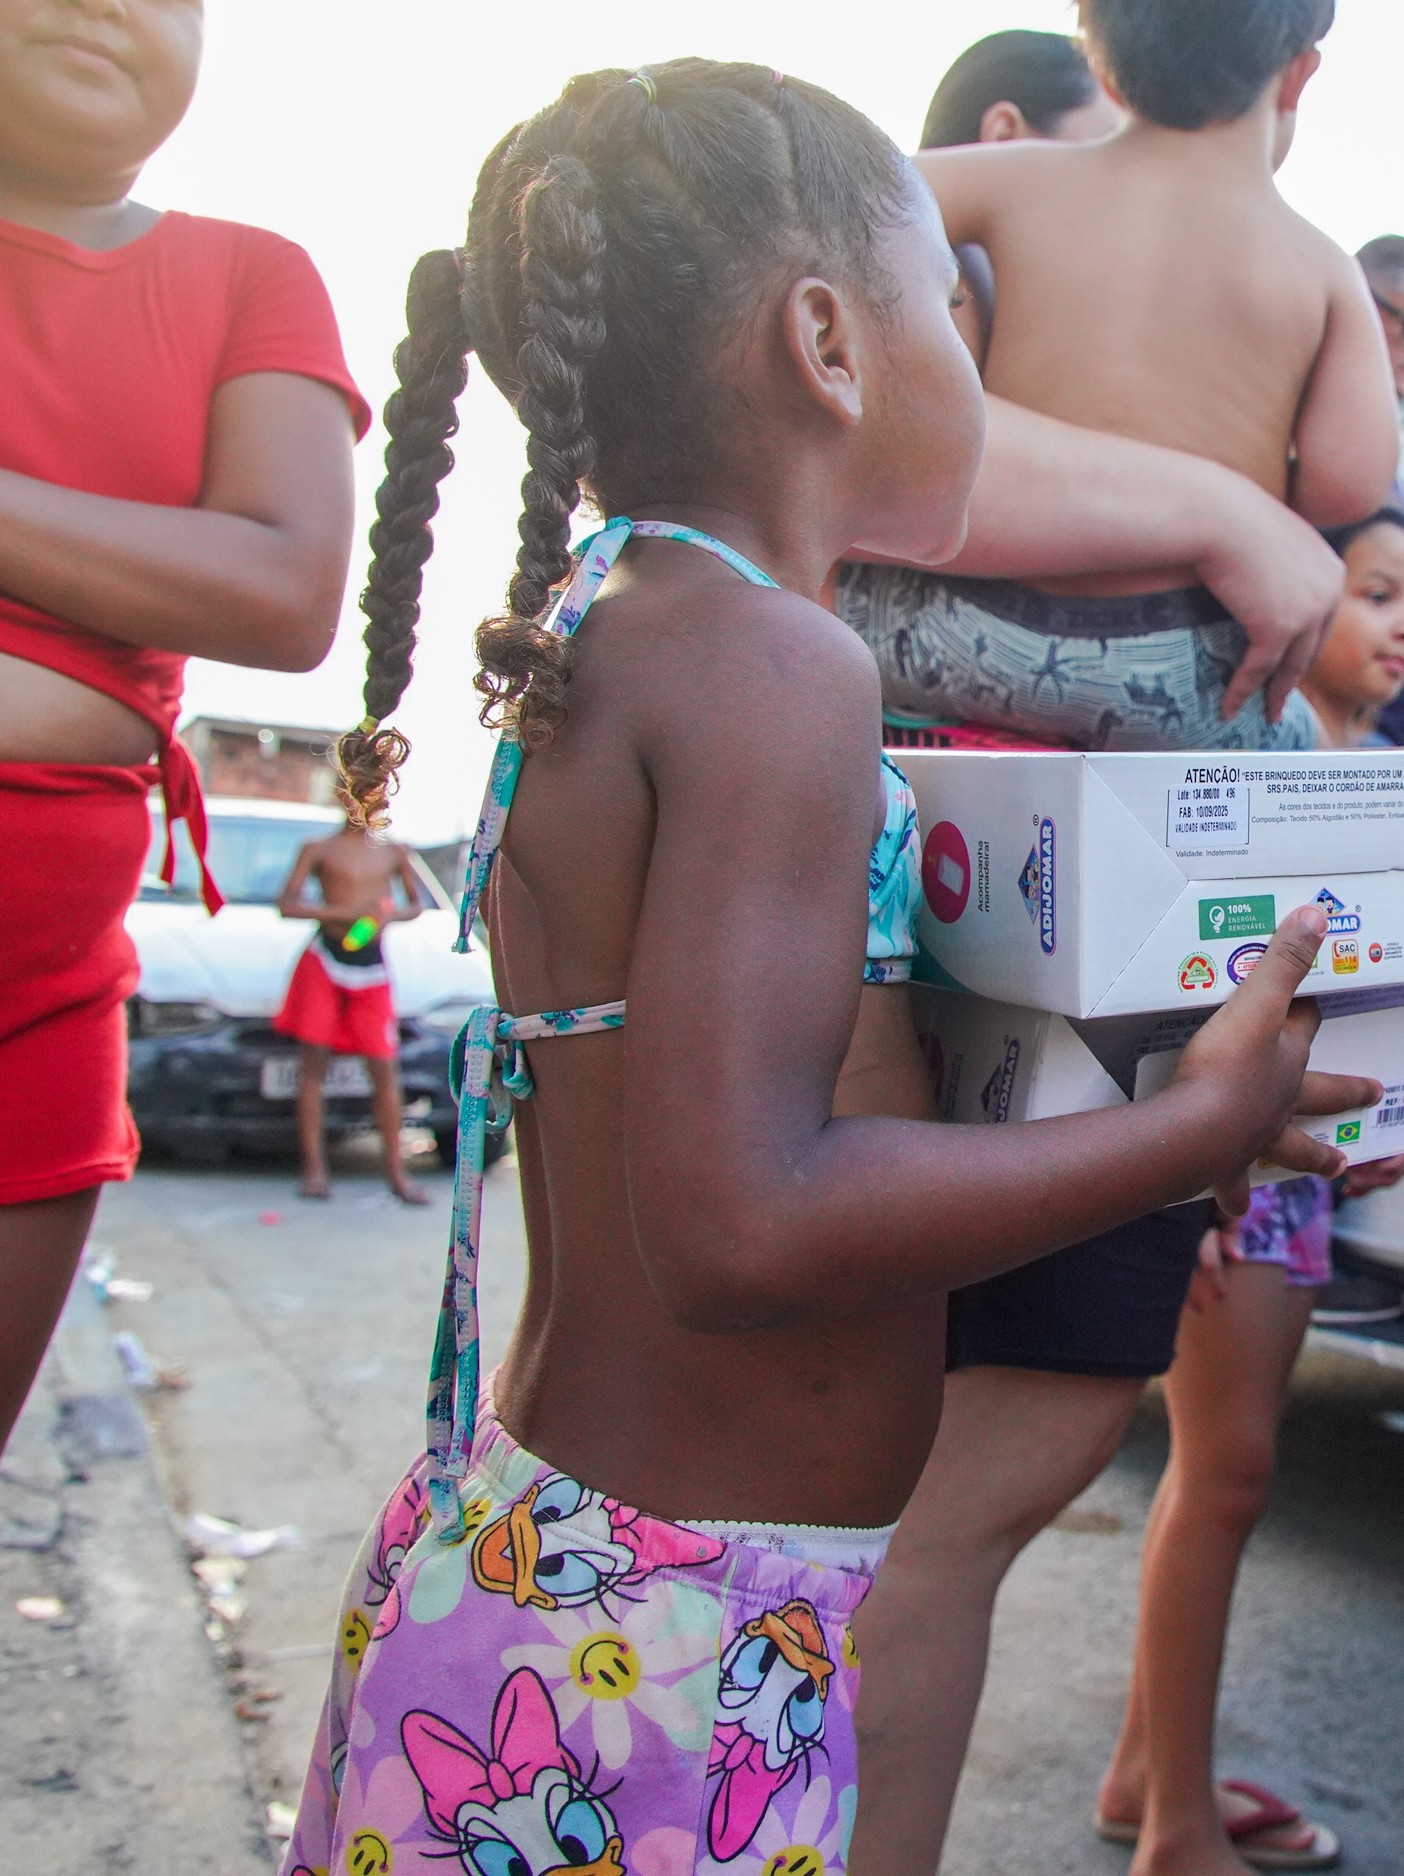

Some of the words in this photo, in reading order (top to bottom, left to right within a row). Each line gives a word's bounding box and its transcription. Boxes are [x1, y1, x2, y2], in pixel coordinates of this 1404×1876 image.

[1185, 765, 1240, 784] ATENÇÃO!
[1265, 771, 1306, 781] BRINQUEDO
[1308, 771, 1326, 780] DEVE
[1328, 770, 1341, 780] SER
[1343, 770, 1375, 779] MONTADO
[1377, 769, 1391, 779] POR
[1392, 769, 1402, 778] UM
[1302, 783, 1328, 793] DEIXAR
[1329, 783, 1334, 792] O
[1336, 781, 1364, 792] CORDÃO
[1366, 782, 1374, 792] DE
[1179, 807, 1194, 818] FAB:
[1196, 805, 1229, 818] 10/09/2025
[1313, 802, 1331, 810] tecidos
[1322, 814, 1344, 822] Algodão
[1175, 822, 1198, 833] VALIDADE
[1200, 821, 1237, 833] INDETERMINADO
[1176, 850, 1205, 858] Validade:
[1206, 849, 1249, 857] Indeterminado
[1042, 825, 1052, 947] ADIJOMAR
[1227, 904, 1251, 914] 100%
[1229, 923, 1266, 931] RENOVÁVEL
[1339, 944, 1355, 953] SAC
[998, 1046, 1018, 1122] JOMAR
